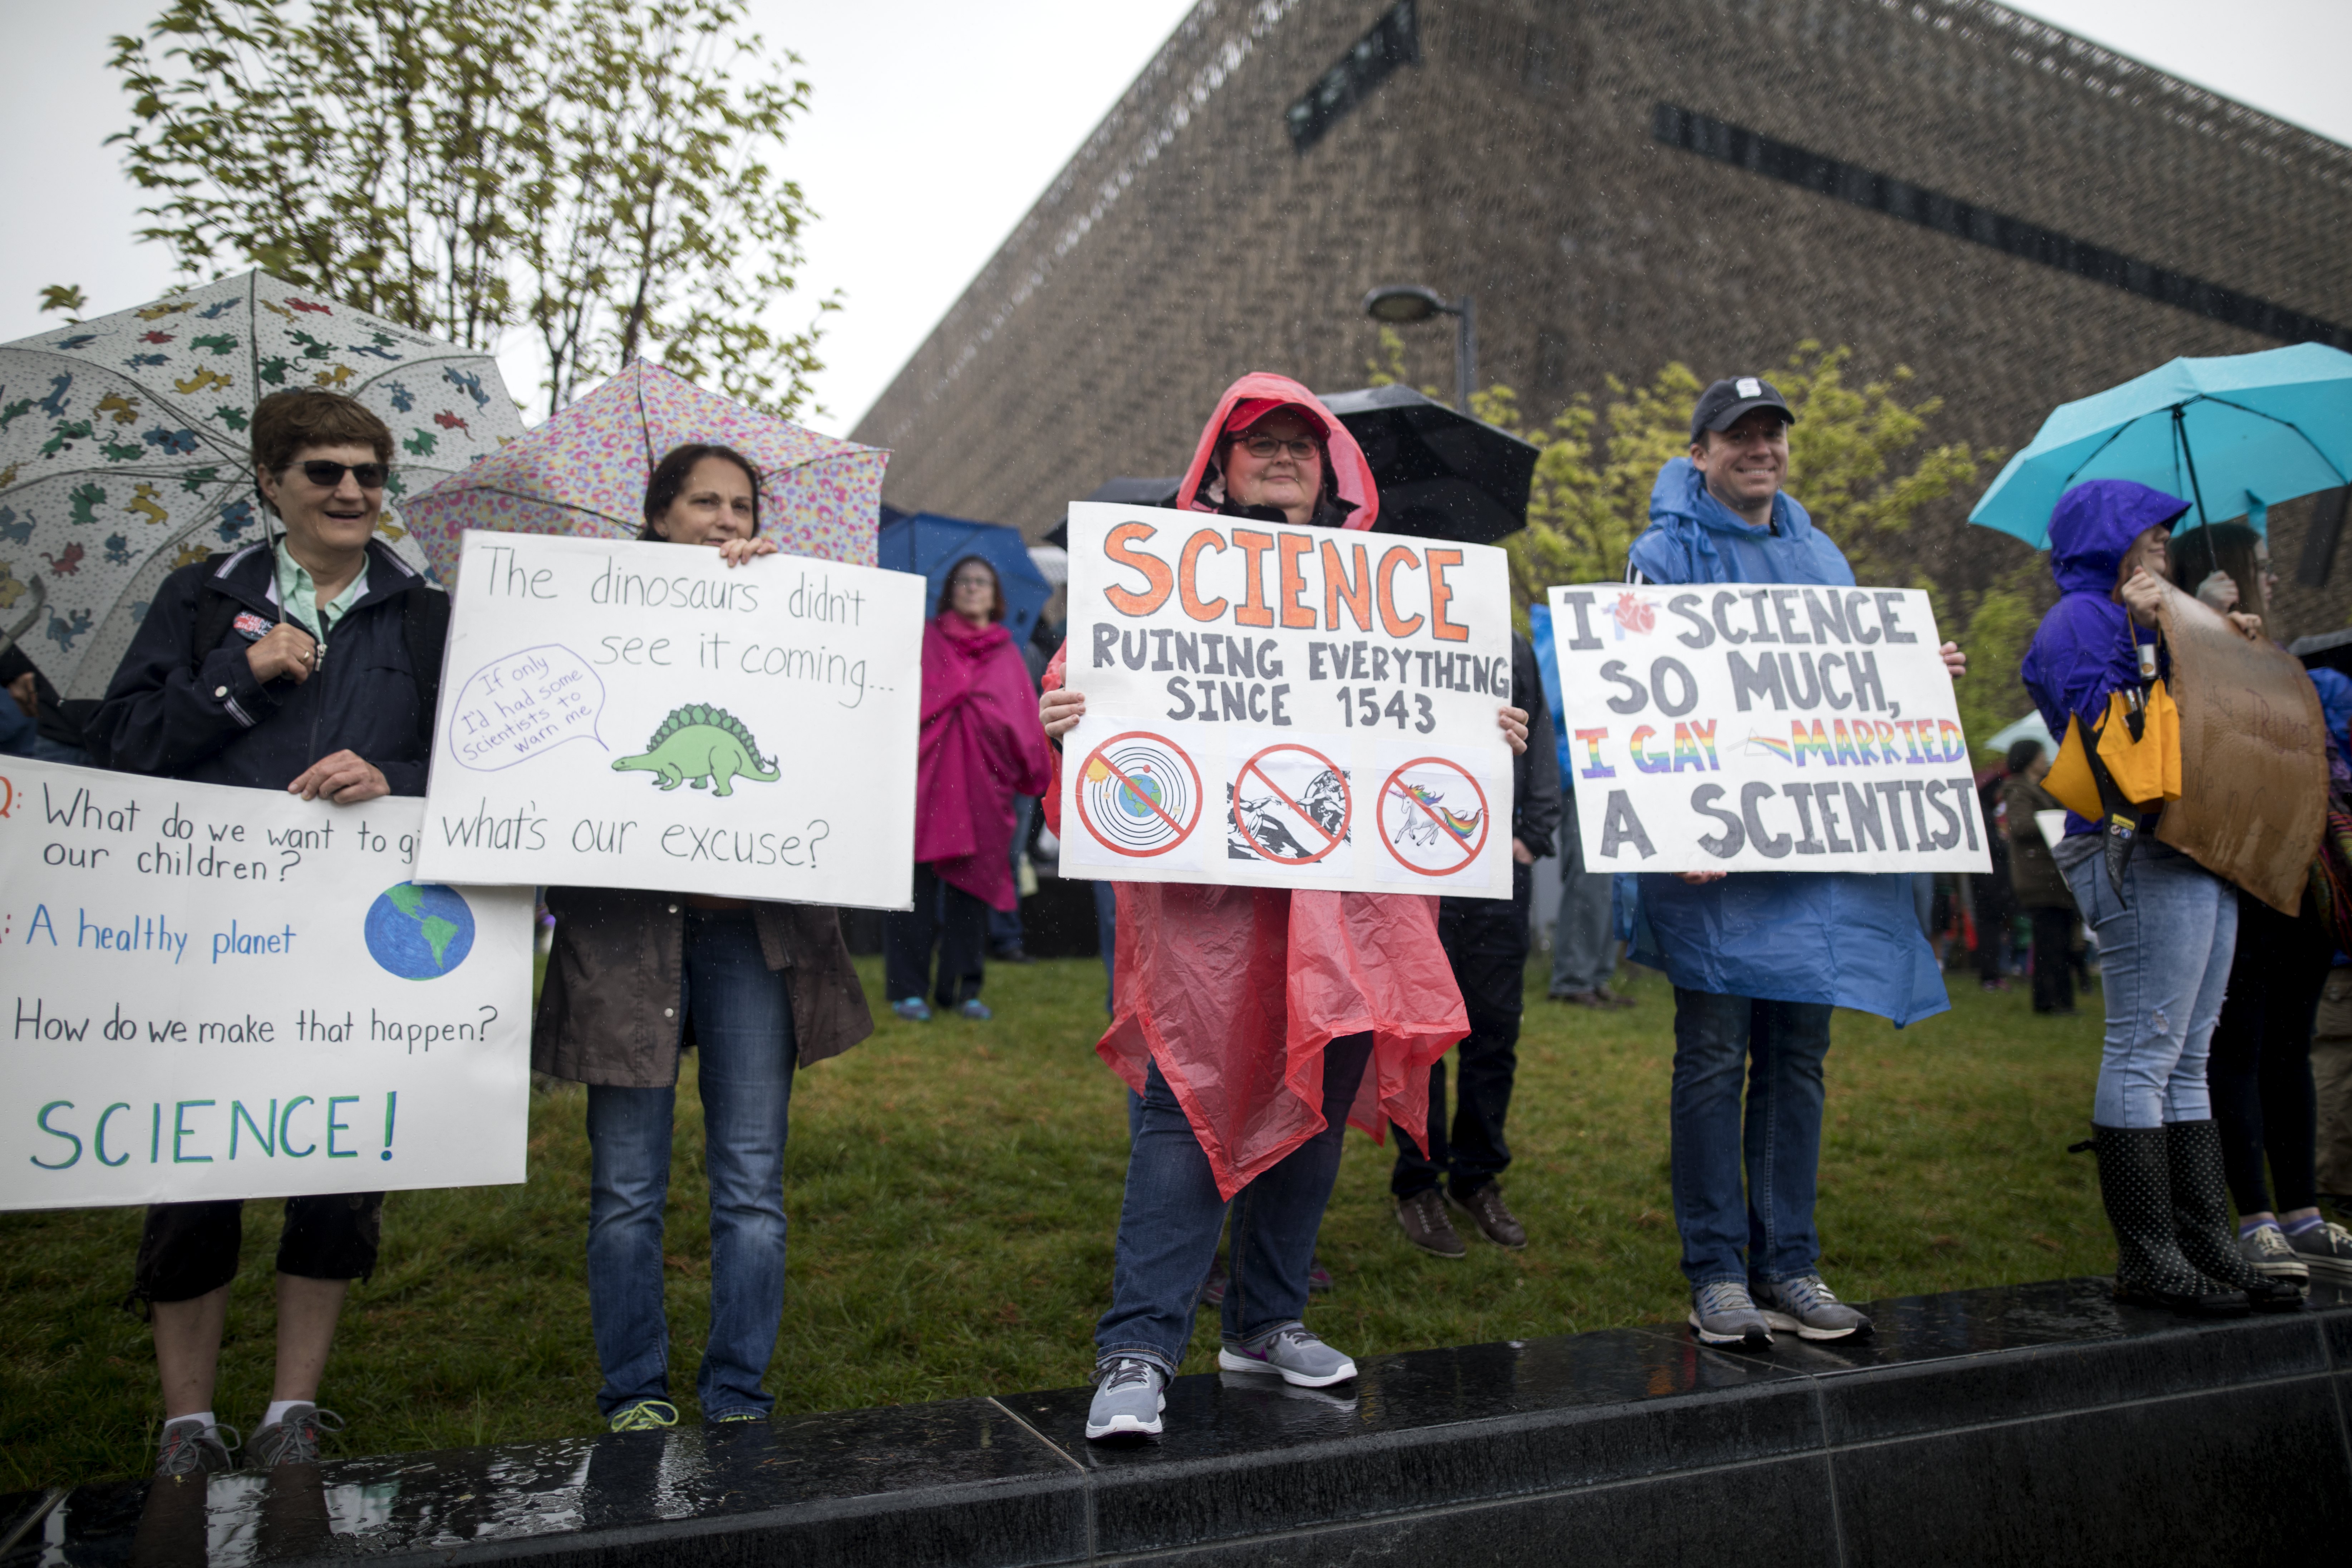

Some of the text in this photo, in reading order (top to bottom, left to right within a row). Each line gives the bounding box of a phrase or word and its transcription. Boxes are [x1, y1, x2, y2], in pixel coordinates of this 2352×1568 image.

[481, 546, 866, 626] The dinosaurs didn't
[1103, 521, 1469, 643] SCIENCE
[237, 622, 269, 636] SILENC
[239, 611, 274, 629] SCIENC
[1564, 589, 1918, 650] I SCIENCE
[478, 655, 549, 696] If only
[594, 636, 671, 665] see
[700, 633, 730, 669] it
[1093, 622, 1510, 698] RUINING EVERYTHING
[461, 670, 583, 735] I'd had some
[558, 692, 581, 708] to
[1166, 676, 1436, 733] SINCE 1543
[1600, 650, 1901, 719] SO MUCH,
[565, 706, 592, 724] me
[1575, 719, 1965, 779] I GAY MARRIED
[43, 782, 141, 832] What
[162, 802, 193, 839] do
[208, 824, 245, 842] we
[267, 820, 334, 849] want
[358, 821, 386, 852] to
[399, 830, 420, 864] gi
[572, 819, 637, 854] our
[661, 819, 830, 868] excuse?
[1600, 777, 1980, 860] A SCIENTIST
[43, 841, 301, 881] our children?
[26, 904, 57, 946] A
[78, 908, 187, 964] healthy
[212, 919, 296, 964] planet
[14, 997, 497, 1055] How do we make that happen?
[30, 1091, 397, 1170] SCIENCE!
